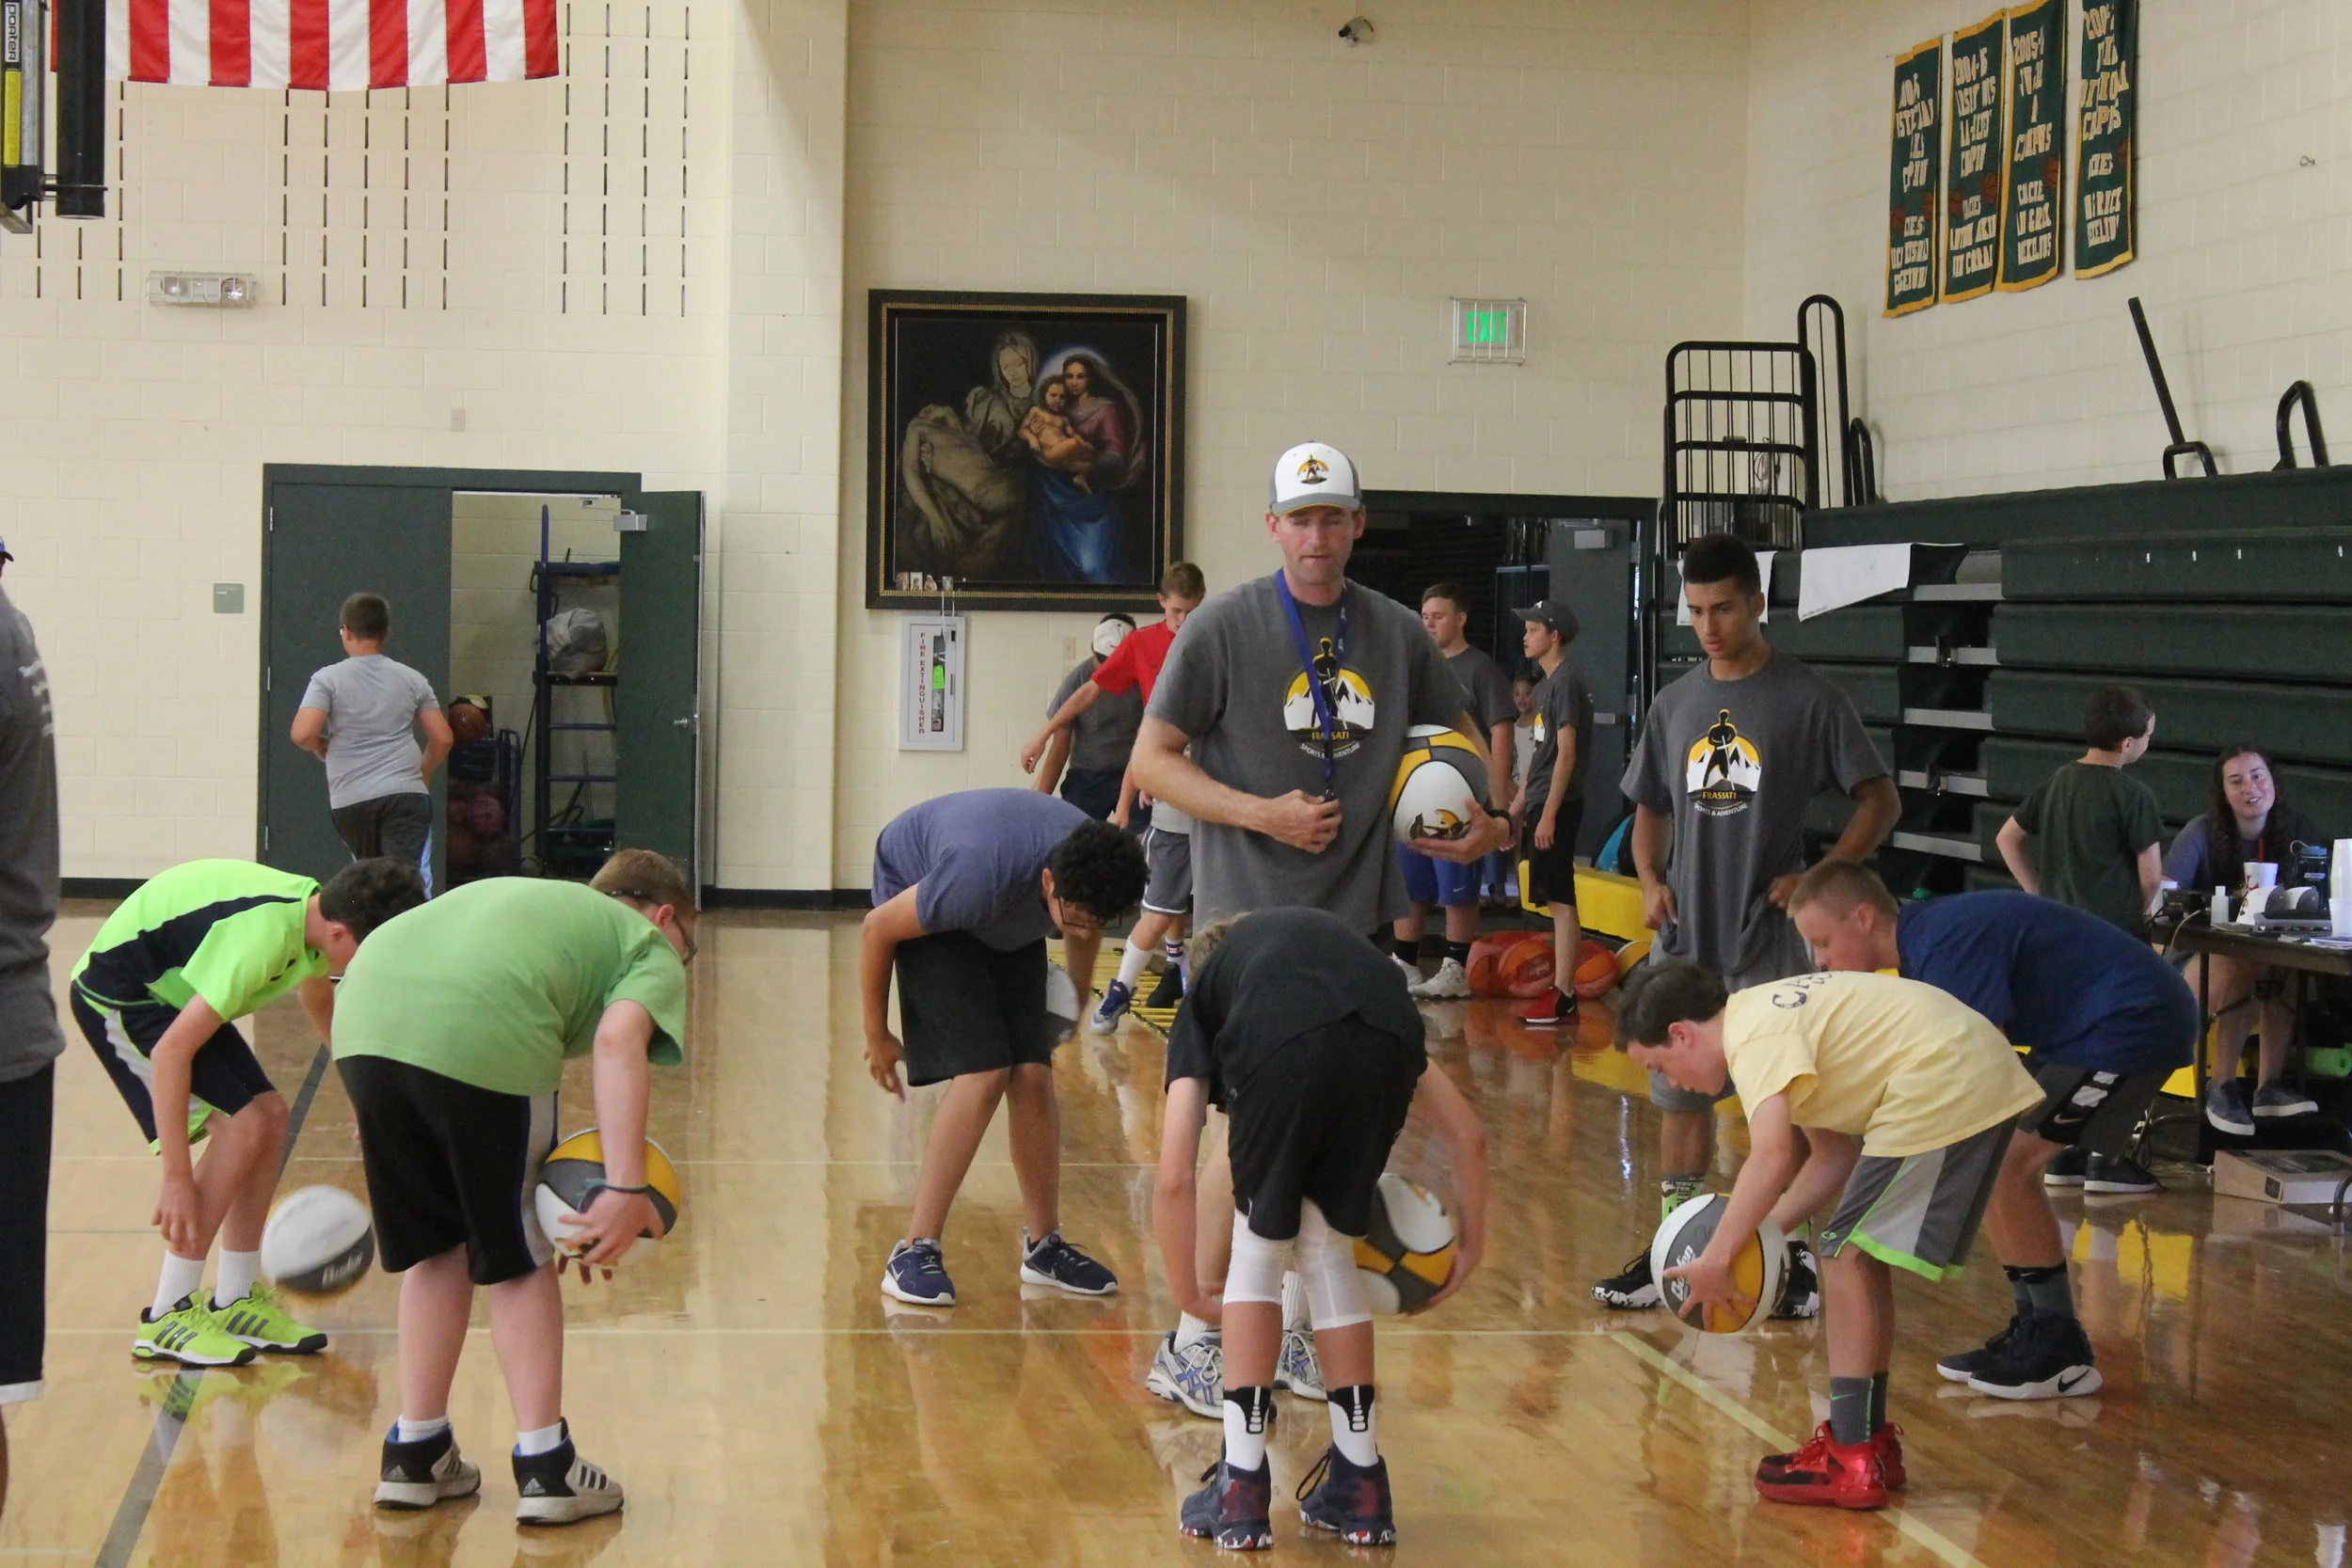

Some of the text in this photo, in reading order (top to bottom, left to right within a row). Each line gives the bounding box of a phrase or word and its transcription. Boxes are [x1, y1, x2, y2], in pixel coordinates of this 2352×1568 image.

[1467, 311, 1507, 342] EXIT
[1702, 791, 1737, 800] FRASSATI
[1716, 802, 1748, 816] ADVENTURE
